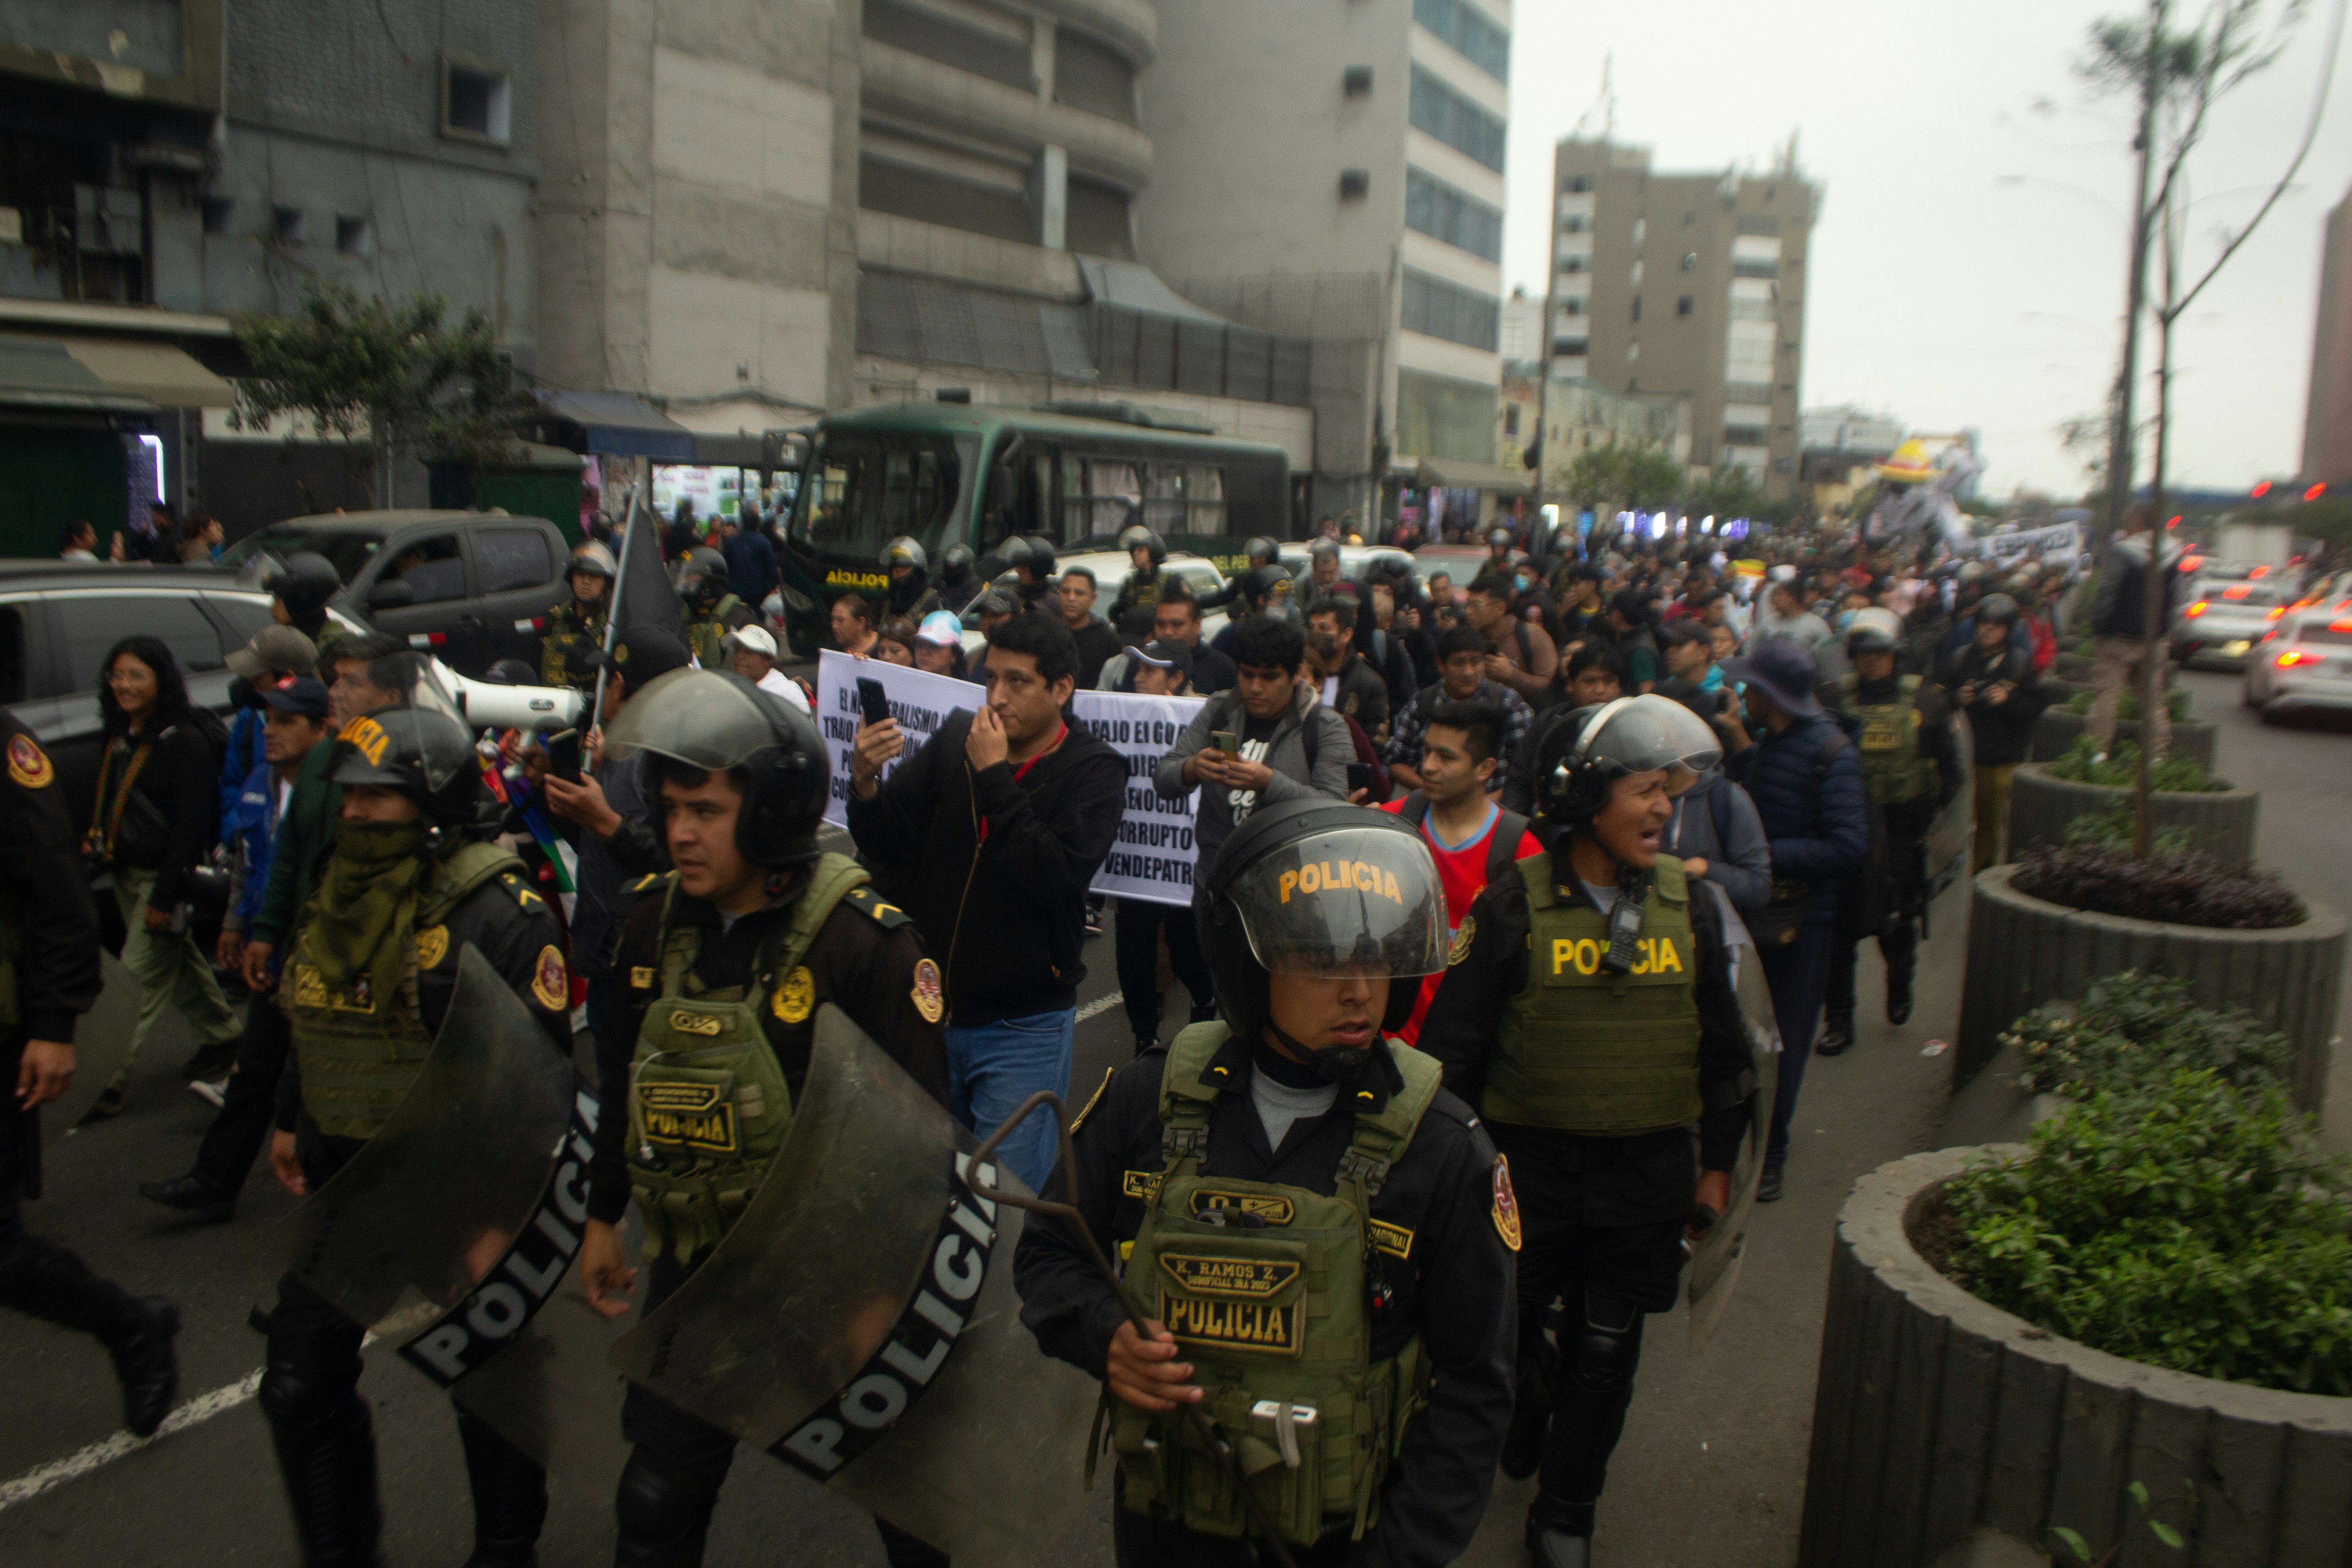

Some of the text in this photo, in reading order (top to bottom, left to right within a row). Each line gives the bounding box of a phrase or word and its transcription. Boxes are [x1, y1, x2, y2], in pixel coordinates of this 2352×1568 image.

[1279, 860, 1403, 905] POLICIA
[1176, 1260, 1279, 1282] K. RAMOS Z.
